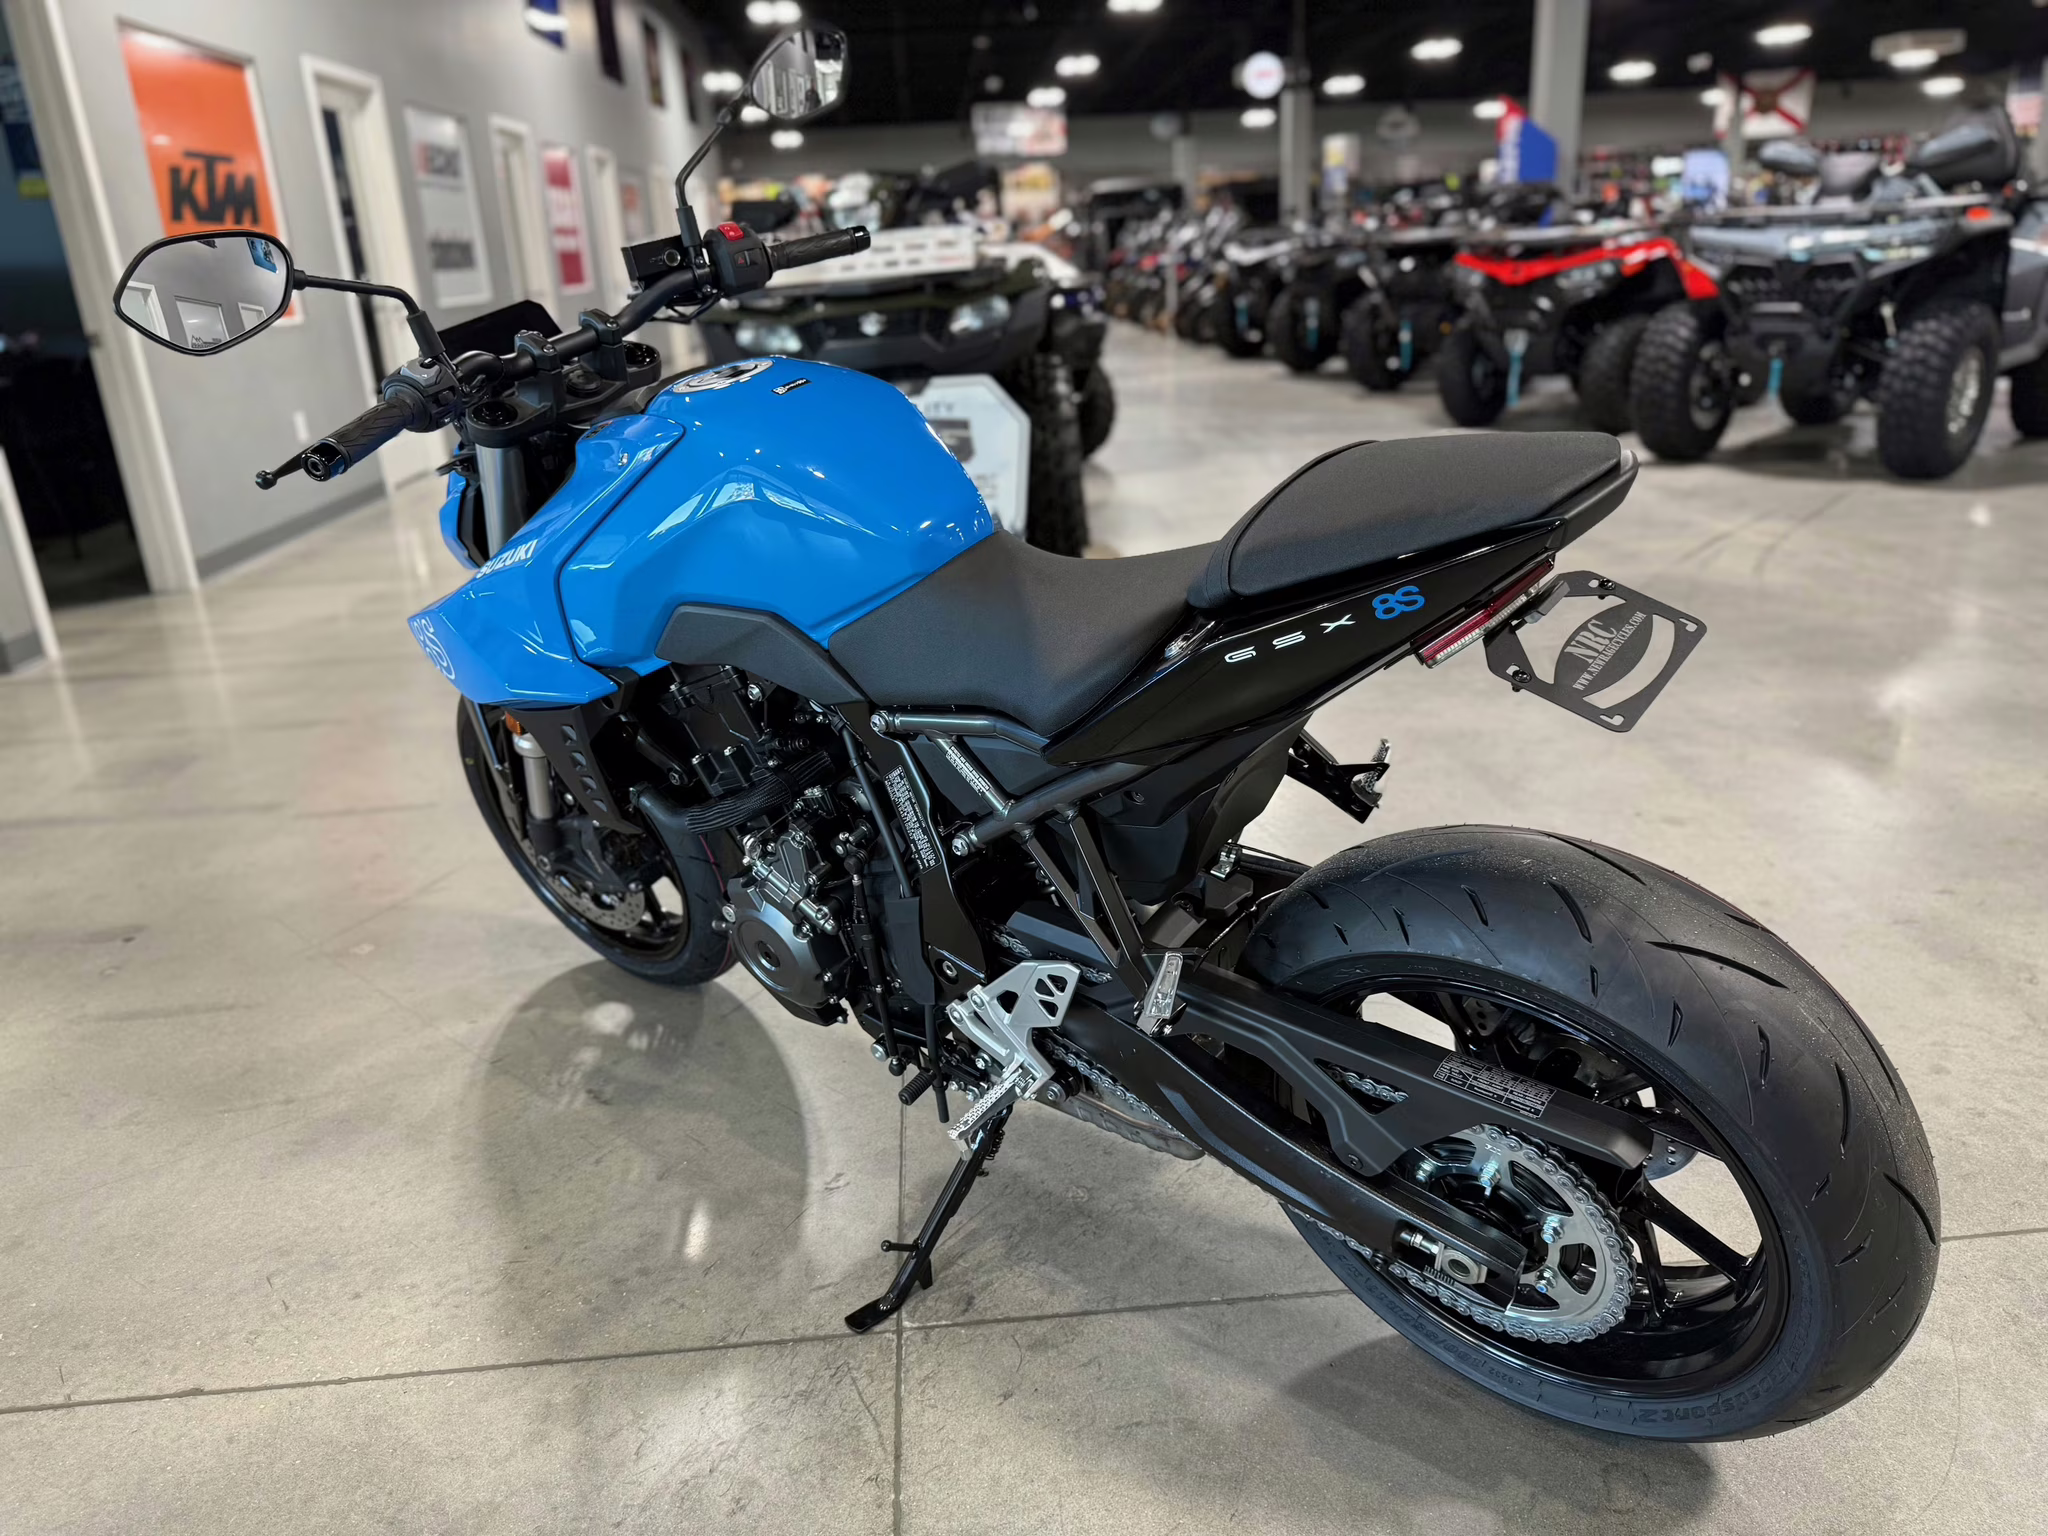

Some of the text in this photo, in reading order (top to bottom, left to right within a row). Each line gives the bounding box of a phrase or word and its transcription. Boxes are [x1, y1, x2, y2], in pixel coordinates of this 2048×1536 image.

[169, 150, 260, 226] KTM
[475, 538, 538, 579] SUZUKI
[1371, 585, 1426, 620] 8S
[1564, 618, 1617, 664] NRC
[1572, 610, 1647, 691] WWW.NEWRAGECYCLES.COM
